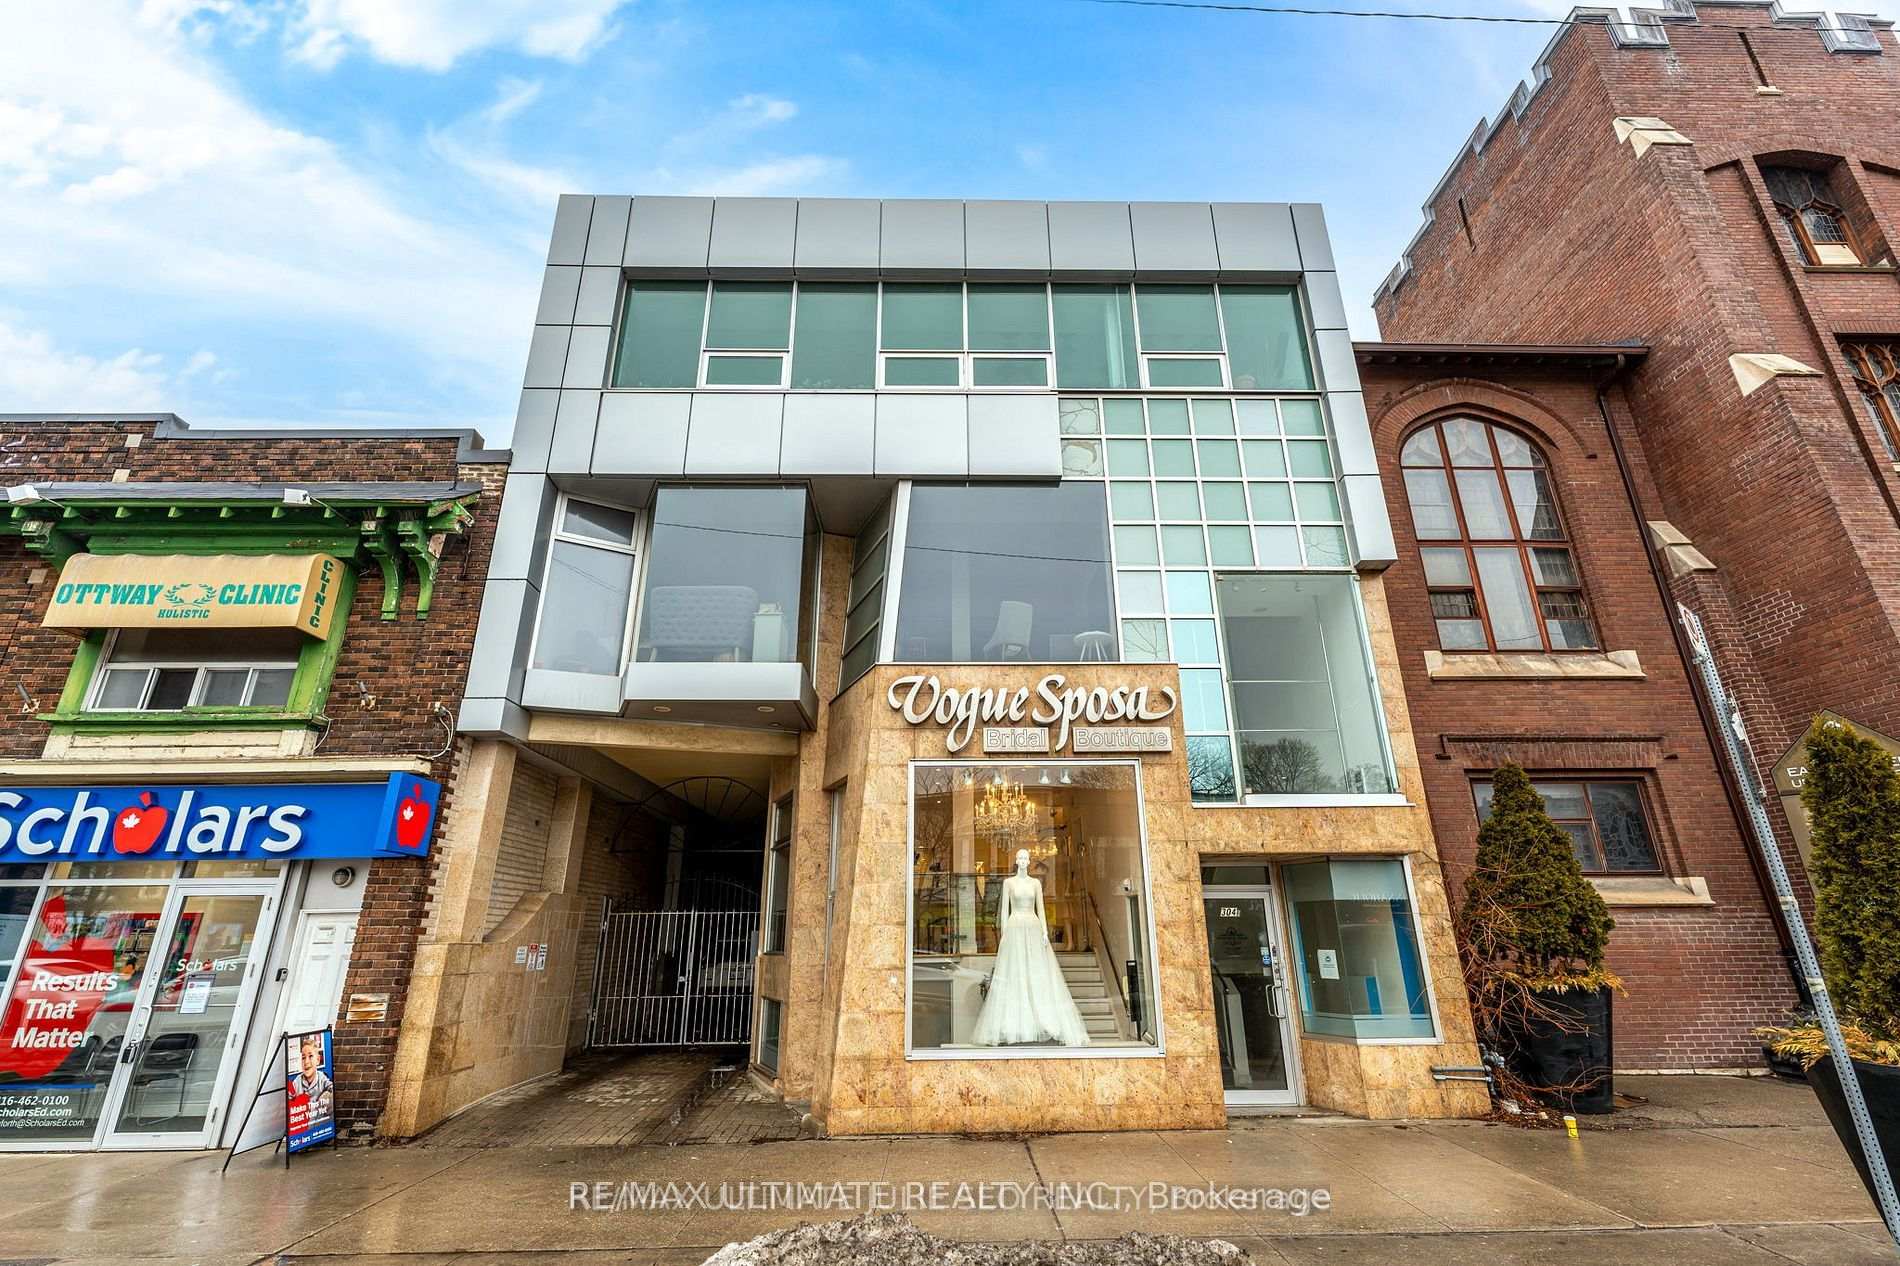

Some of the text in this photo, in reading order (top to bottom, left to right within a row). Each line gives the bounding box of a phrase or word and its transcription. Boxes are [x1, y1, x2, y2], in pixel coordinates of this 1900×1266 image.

[56, 583, 302, 605] OTTWAY CLINIC
[309, 559, 334, 629] CLINIC
[157, 609, 210, 619] HOLISTIC
[888, 674, 1176, 752] Vogue Sposa
[986, 728, 1168, 749] Bridal Boutique
[31, 970, 119, 992] Results
[26, 998, 78, 1020] That
[11, 1026, 95, 1048] Matter
[0, 1095, 69, 1106] 16-462-0100
[290, 1113, 305, 1124] Best
